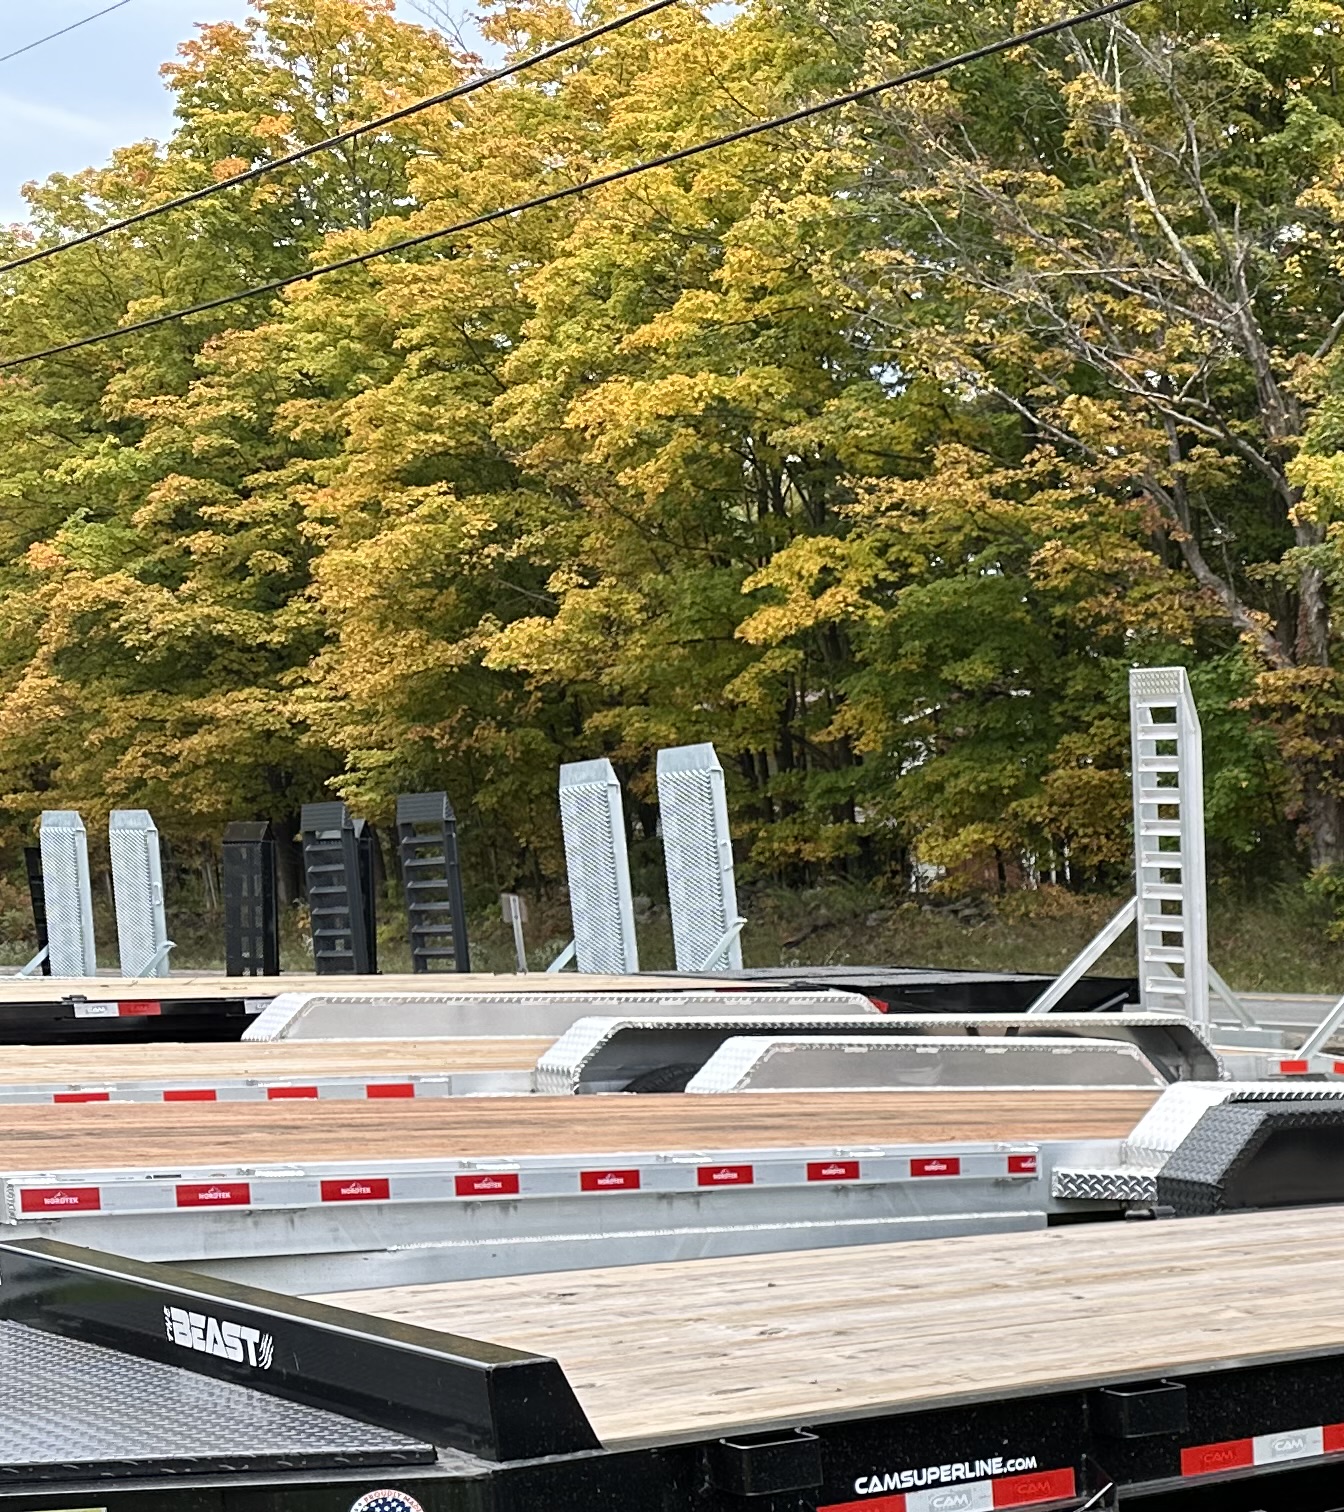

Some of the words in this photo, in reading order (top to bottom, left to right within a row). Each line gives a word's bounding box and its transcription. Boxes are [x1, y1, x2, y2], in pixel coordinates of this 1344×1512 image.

[170, 1306, 260, 1367] BEAST
[1273, 1438, 1304, 1450] CAM
[853, 1456, 1038, 1495] CAMSUPERLINE.COM
[932, 1493, 969, 1508] CAM
